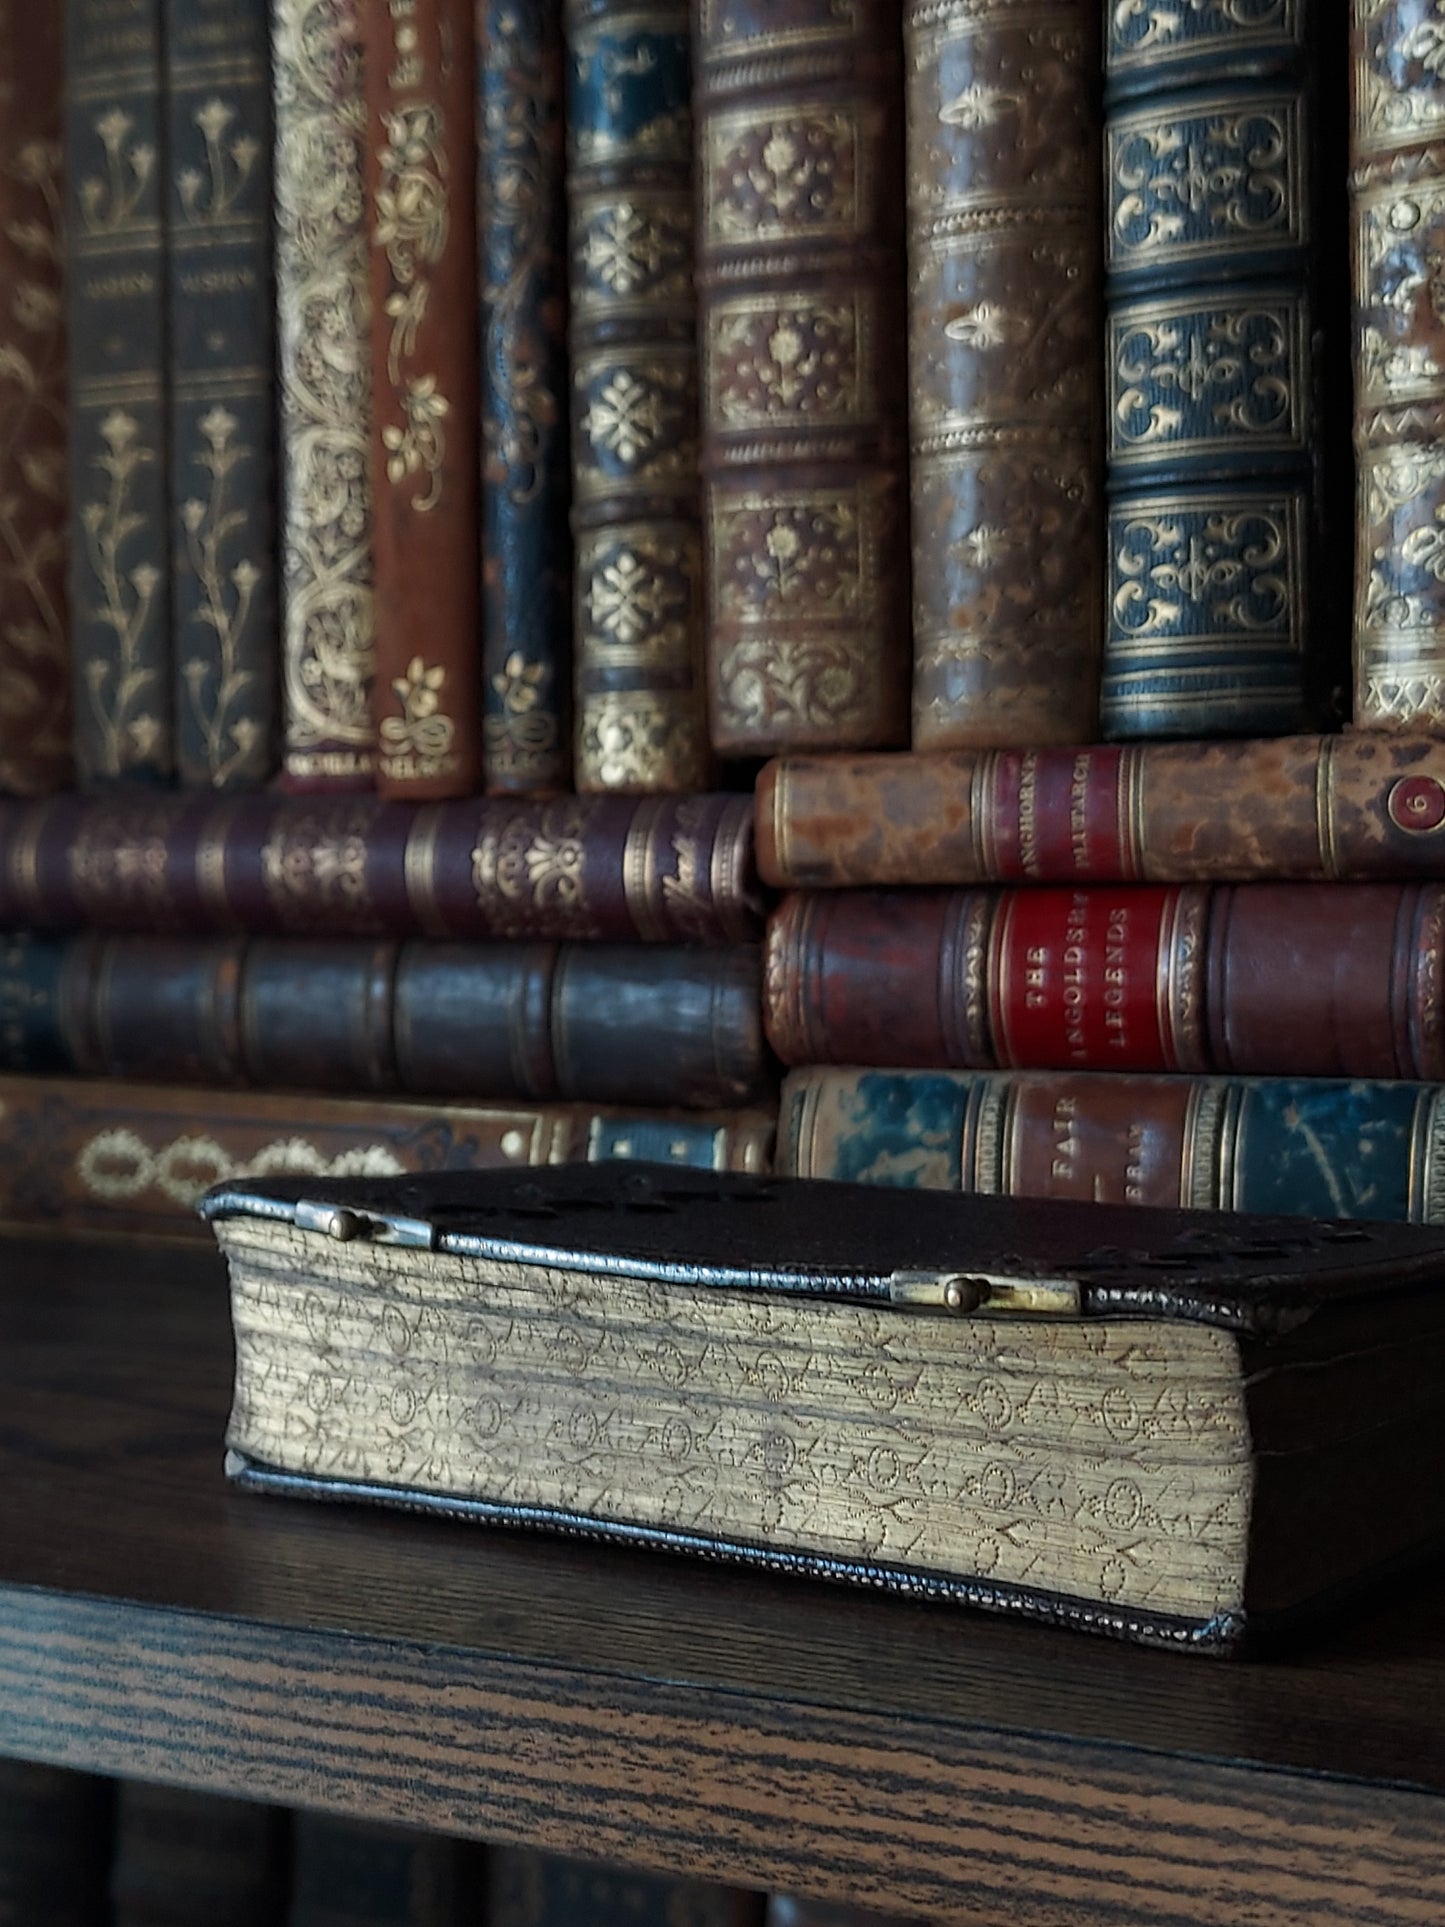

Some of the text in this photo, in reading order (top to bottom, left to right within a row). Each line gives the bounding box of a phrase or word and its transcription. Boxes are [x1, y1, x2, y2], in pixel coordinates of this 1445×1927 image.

[1071, 754, 1089, 870] PLUTARCH
[1026, 946, 1047, 1008] THE
[1063, 893, 1088, 1058] INGOLDSBY
[1105, 908, 1127, 1047] LEGENDS
[1052, 1097, 1076, 1179] FAIR
